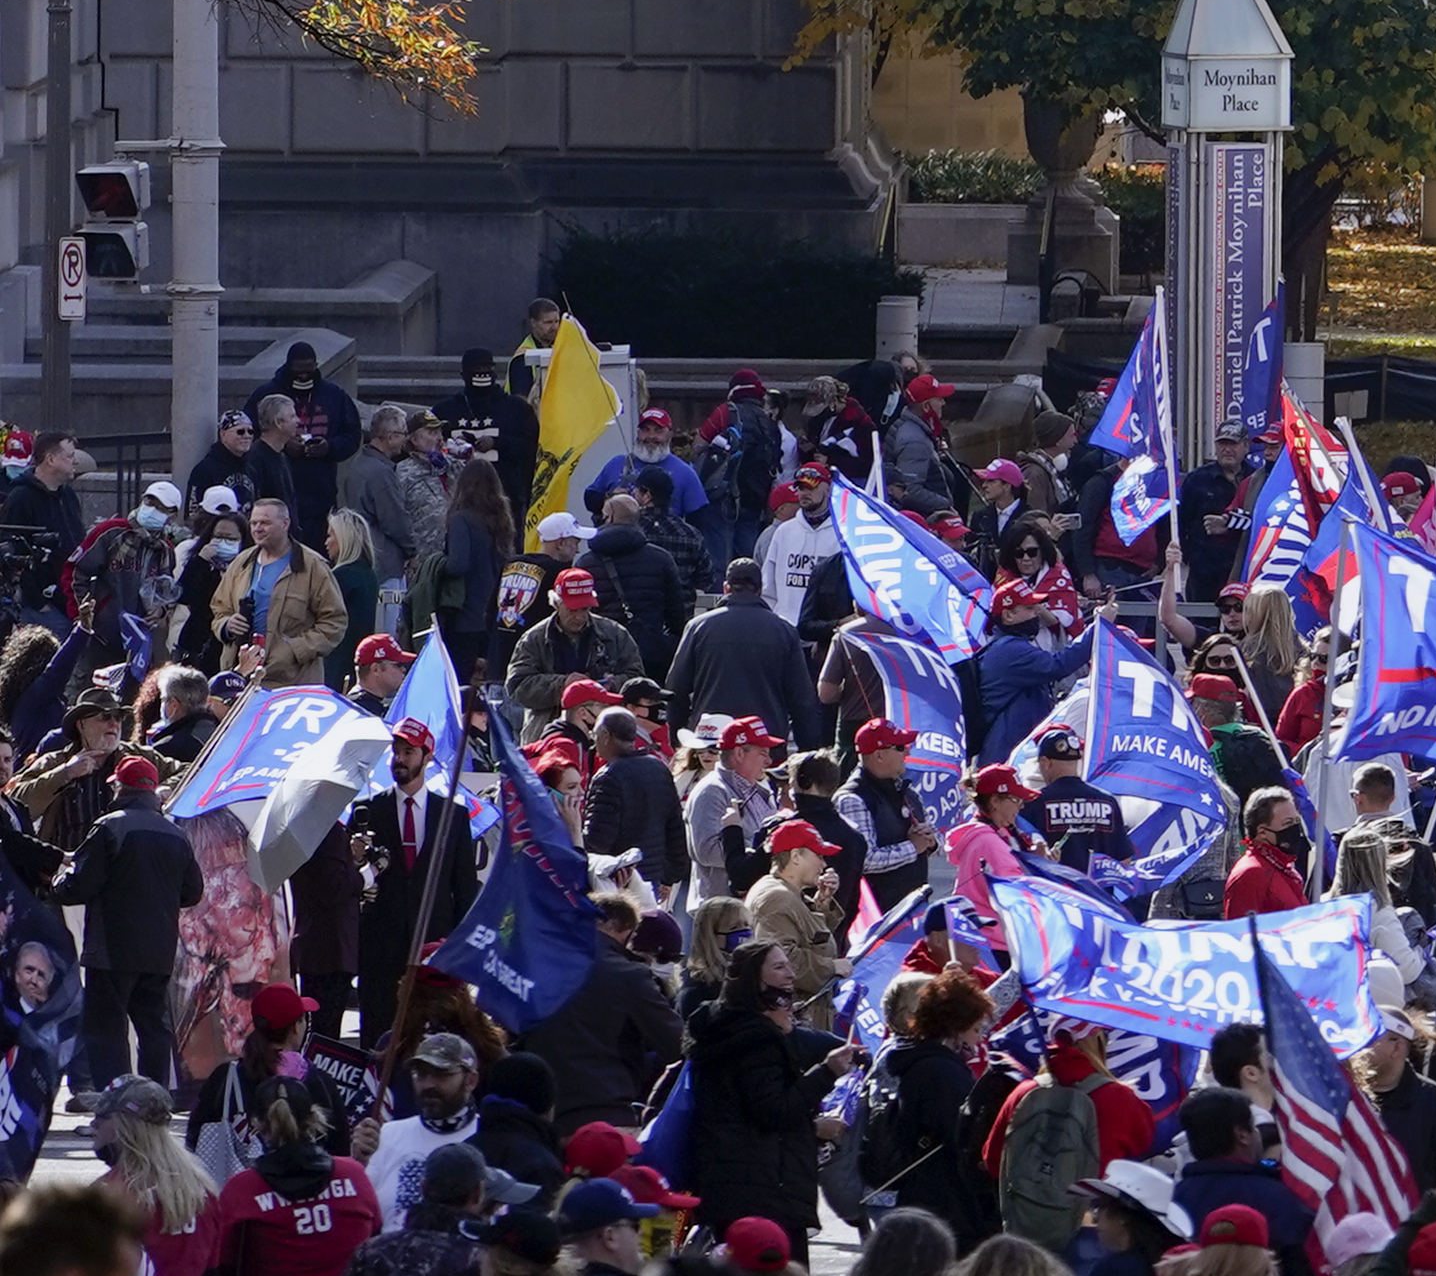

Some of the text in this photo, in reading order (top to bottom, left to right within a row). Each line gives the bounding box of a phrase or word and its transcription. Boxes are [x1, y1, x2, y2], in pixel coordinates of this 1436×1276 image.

[1204, 69, 1277, 90] Moynihan
[1222, 93, 1259, 112] Place
[1247, 152, 1264, 209] Place
[1225, 152, 1249, 422] Daniel Patrick Moynihan
[787, 553, 815, 567] COPS
[500, 574, 537, 591] TRUMP
[225, 678, 245, 688] USA
[1375, 704, 1421, 737] NO
[1111, 734, 1166, 759] MAKE
[1045, 802, 1113, 820] TRUMP
[1124, 961, 1250, 1014] 2020
[312, 1053, 362, 1087] MAKE
[293, 1203, 333, 1236] 20
